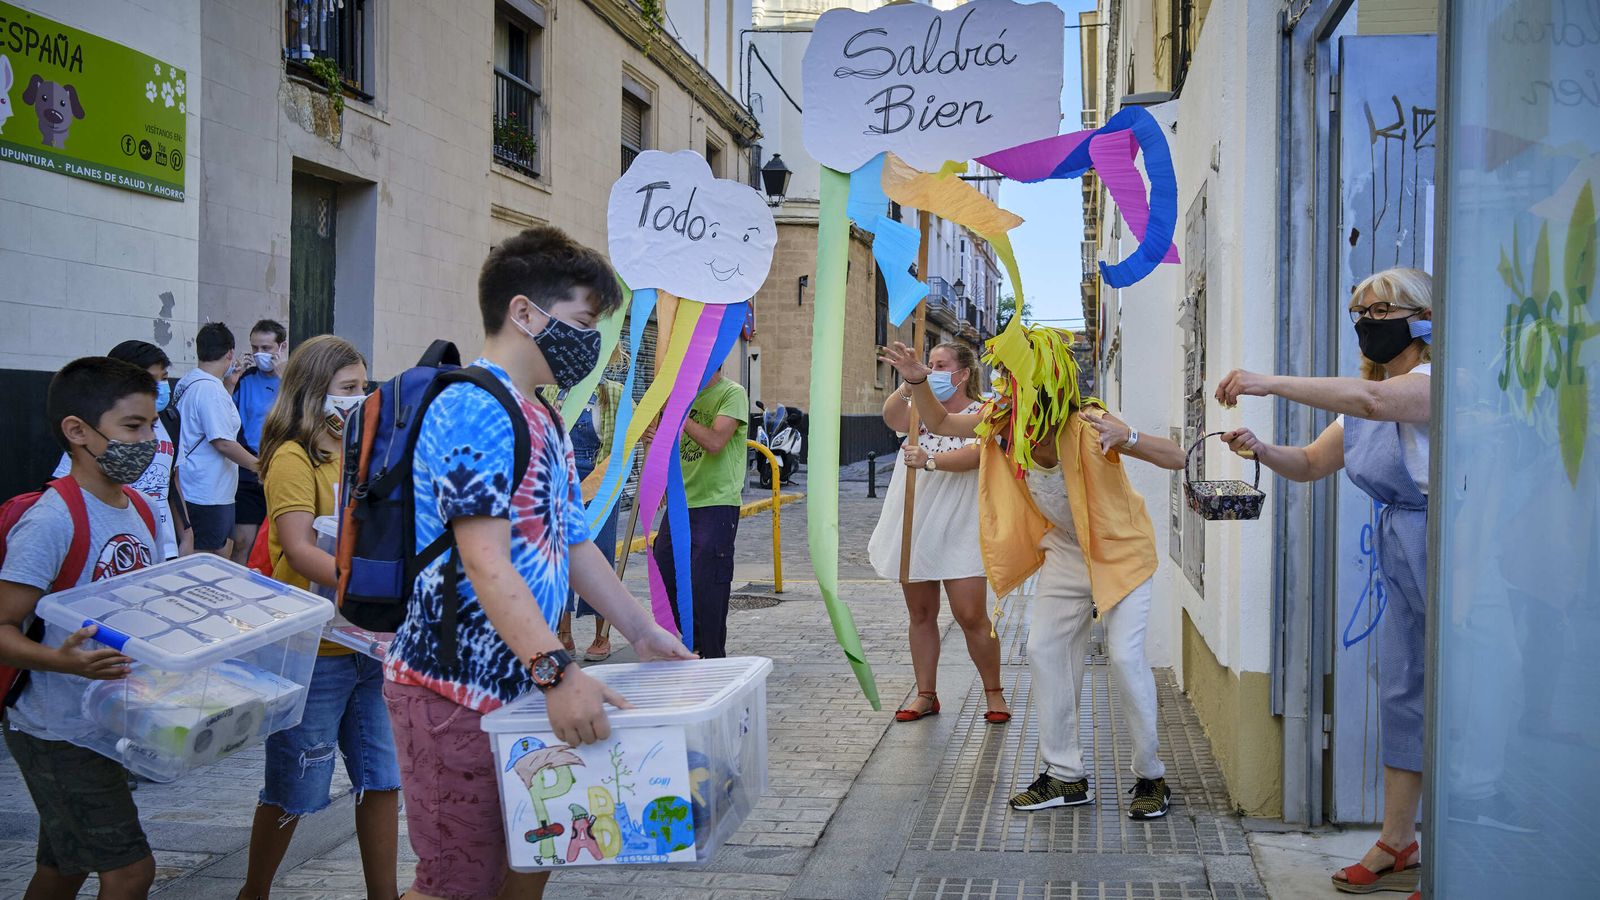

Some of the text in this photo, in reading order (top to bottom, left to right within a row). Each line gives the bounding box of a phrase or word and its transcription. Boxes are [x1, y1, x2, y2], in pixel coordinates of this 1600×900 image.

[834, 8, 1017, 80] Saldrá
[863, 84, 993, 136] Bien
[65, 163, 102, 180] PLANES
[104, 172, 117, 183] DE
[118, 176, 146, 189] SALUD
[147, 182, 153, 191] Y
[154, 185, 185, 200] AHORRO
[636, 181, 706, 242] Todo
